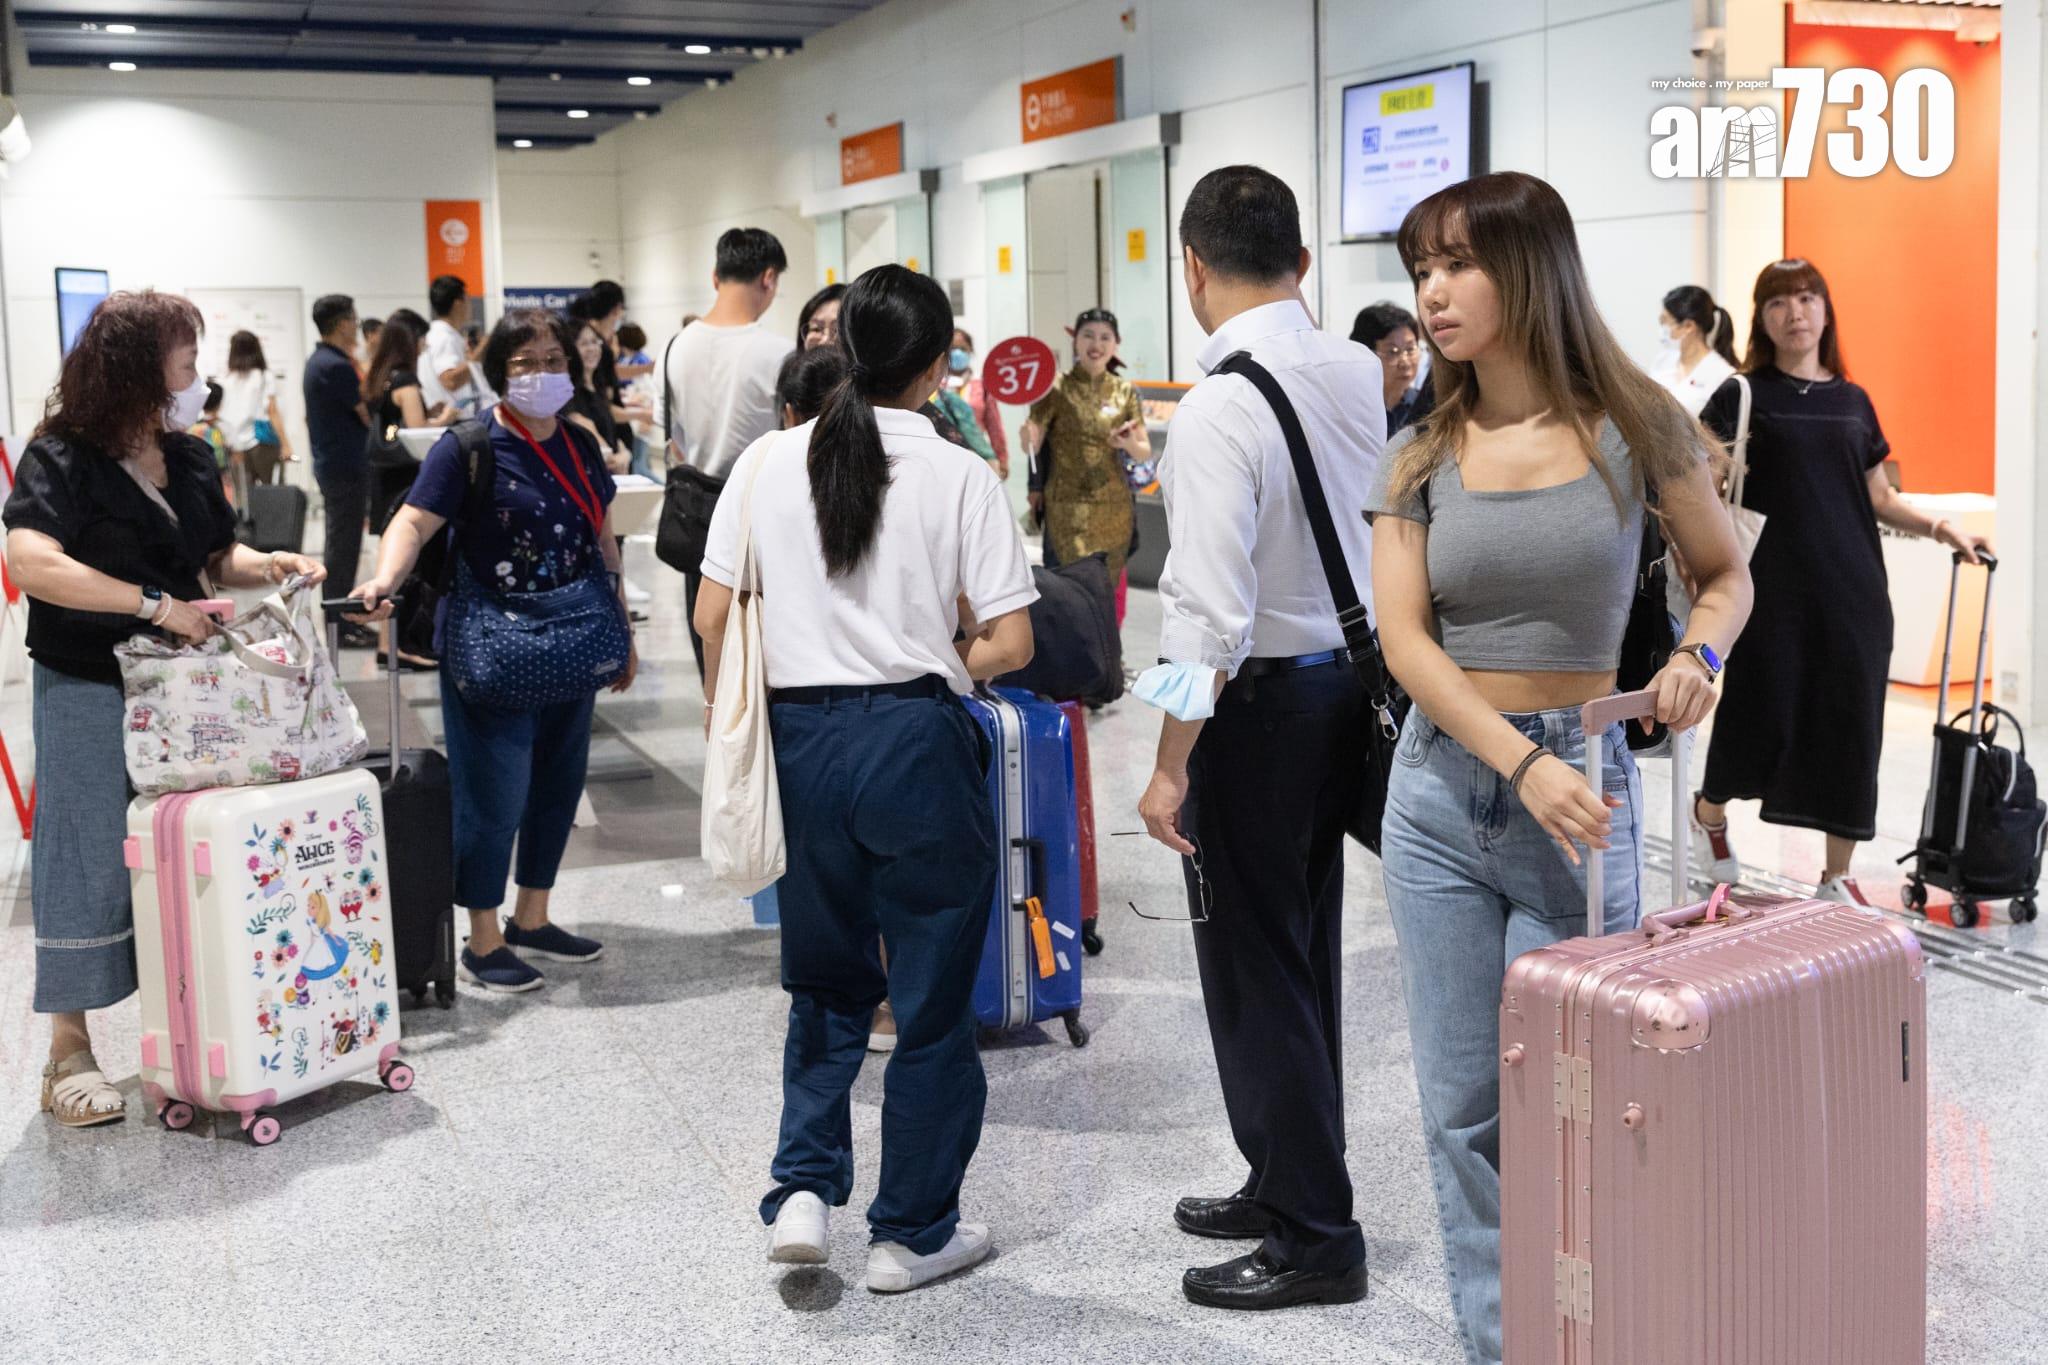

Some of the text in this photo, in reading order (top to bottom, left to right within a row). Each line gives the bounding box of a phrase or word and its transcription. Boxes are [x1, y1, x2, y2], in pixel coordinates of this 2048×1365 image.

[504, 293, 542, 308] rivate
[997, 361, 1040, 395] 37
[295, 841, 334, 863] ALICE
